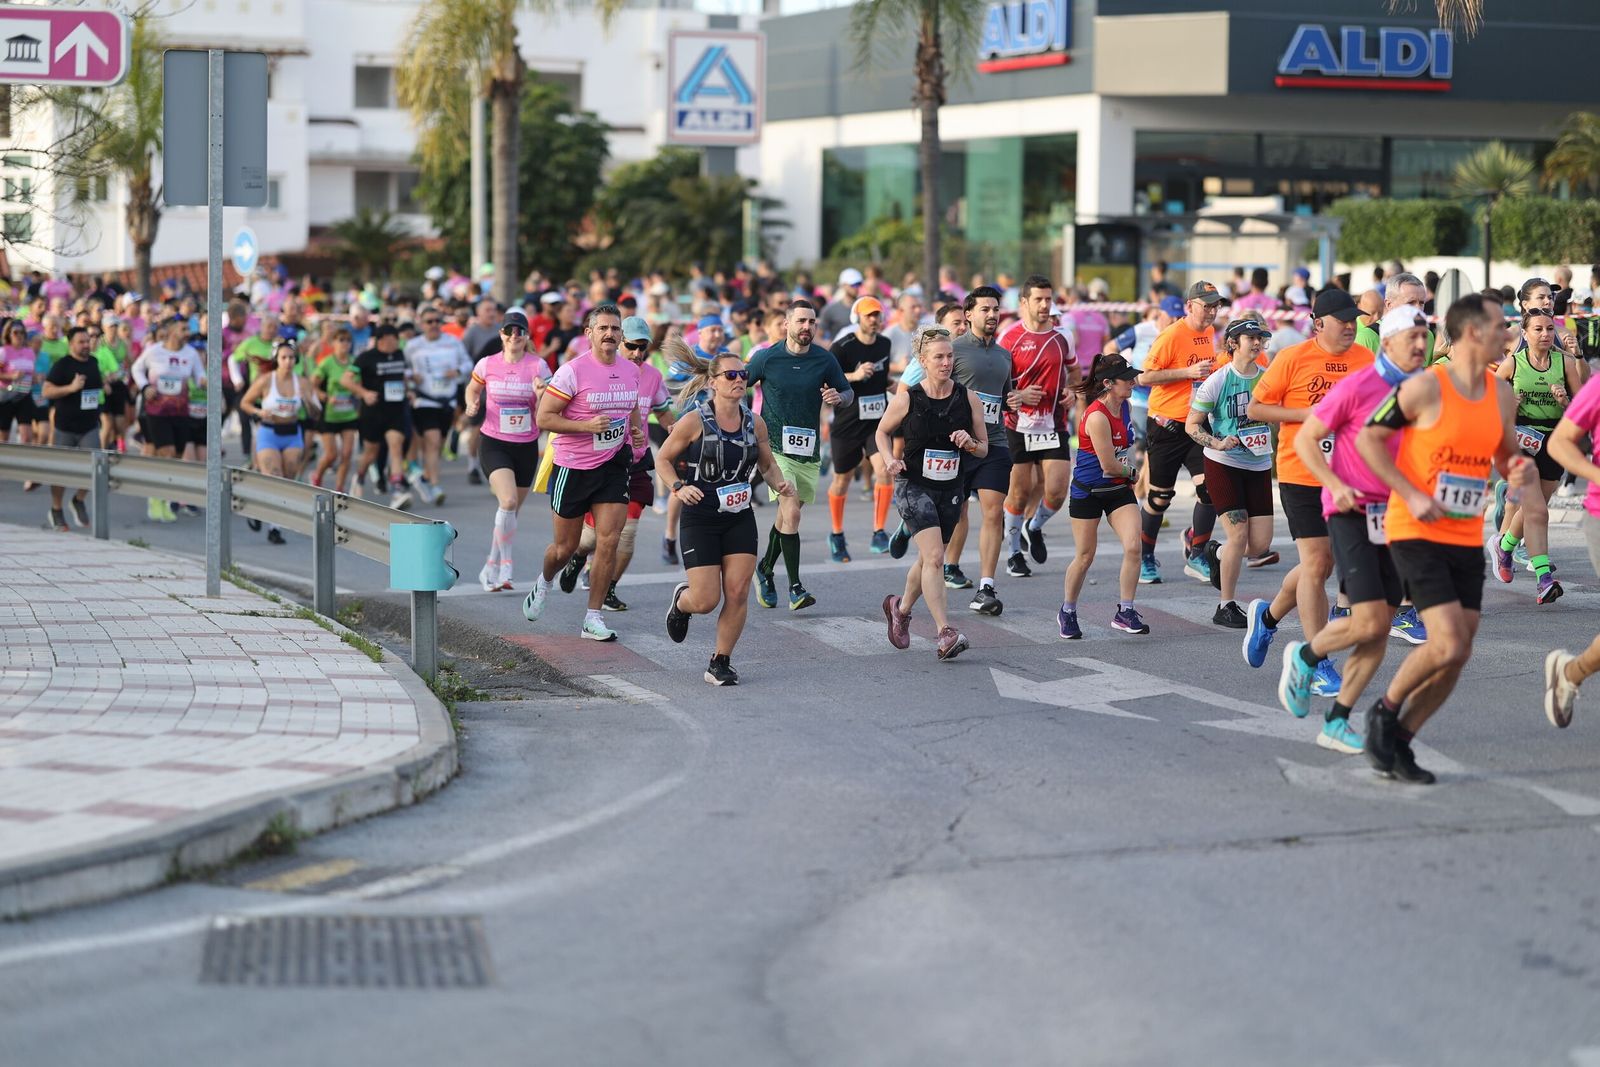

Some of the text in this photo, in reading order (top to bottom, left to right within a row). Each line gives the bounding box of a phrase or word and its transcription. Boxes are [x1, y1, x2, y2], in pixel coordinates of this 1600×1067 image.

[979, 0, 1066, 59] ALDI
[1278, 24, 1453, 79] ALDI
[682, 111, 748, 131] ALDI
[1193, 336, 1210, 346] STEVE
[1325, 363, 1348, 373] GREG
[608, 383, 626, 391] XXXVI
[586, 391, 613, 403] MEDIA
[1519, 388, 1553, 399] Portersto
[862, 402, 885, 412] 1401
[509, 416, 524, 425] 57
[596, 425, 625, 441] 1802
[1027, 433, 1058, 442] 1712
[788, 434, 810, 447] 851
[1245, 434, 1267, 448] 243
[926, 459, 957, 471] 1741
[726, 490, 748, 506] 838
[1440, 486, 1483, 508] 1187
